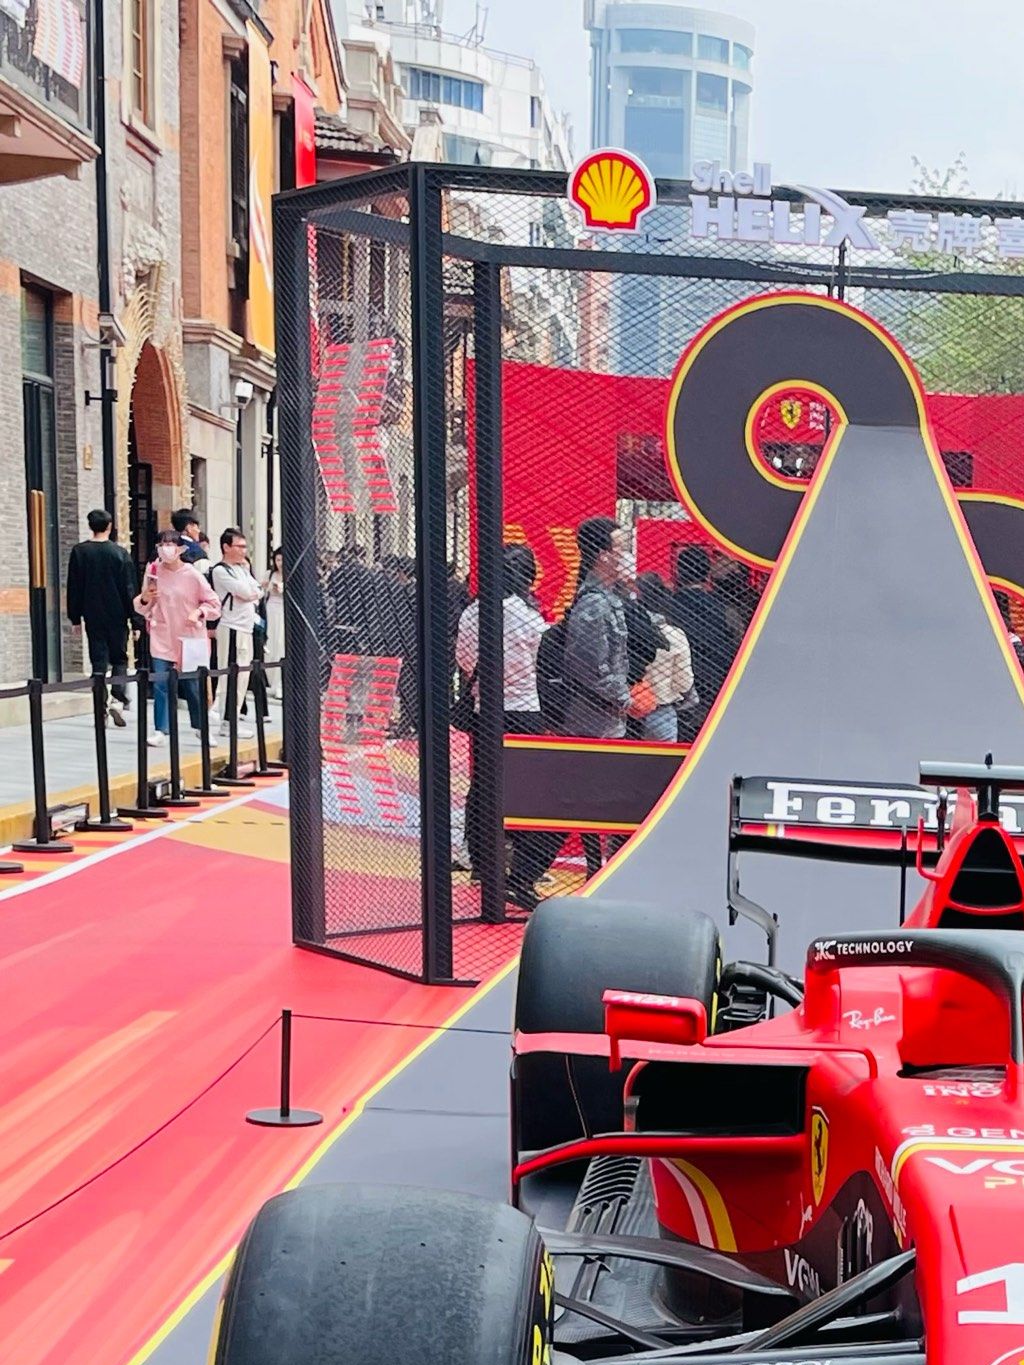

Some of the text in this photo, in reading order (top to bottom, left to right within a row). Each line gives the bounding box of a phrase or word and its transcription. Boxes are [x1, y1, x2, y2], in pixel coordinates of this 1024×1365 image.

[691, 159, 772, 196] Shell
[689, 184, 881, 250] HELIX
[837, 941, 914, 955] TECHNOLOGY
[842, 1007, 896, 1030] Ray-Ban
